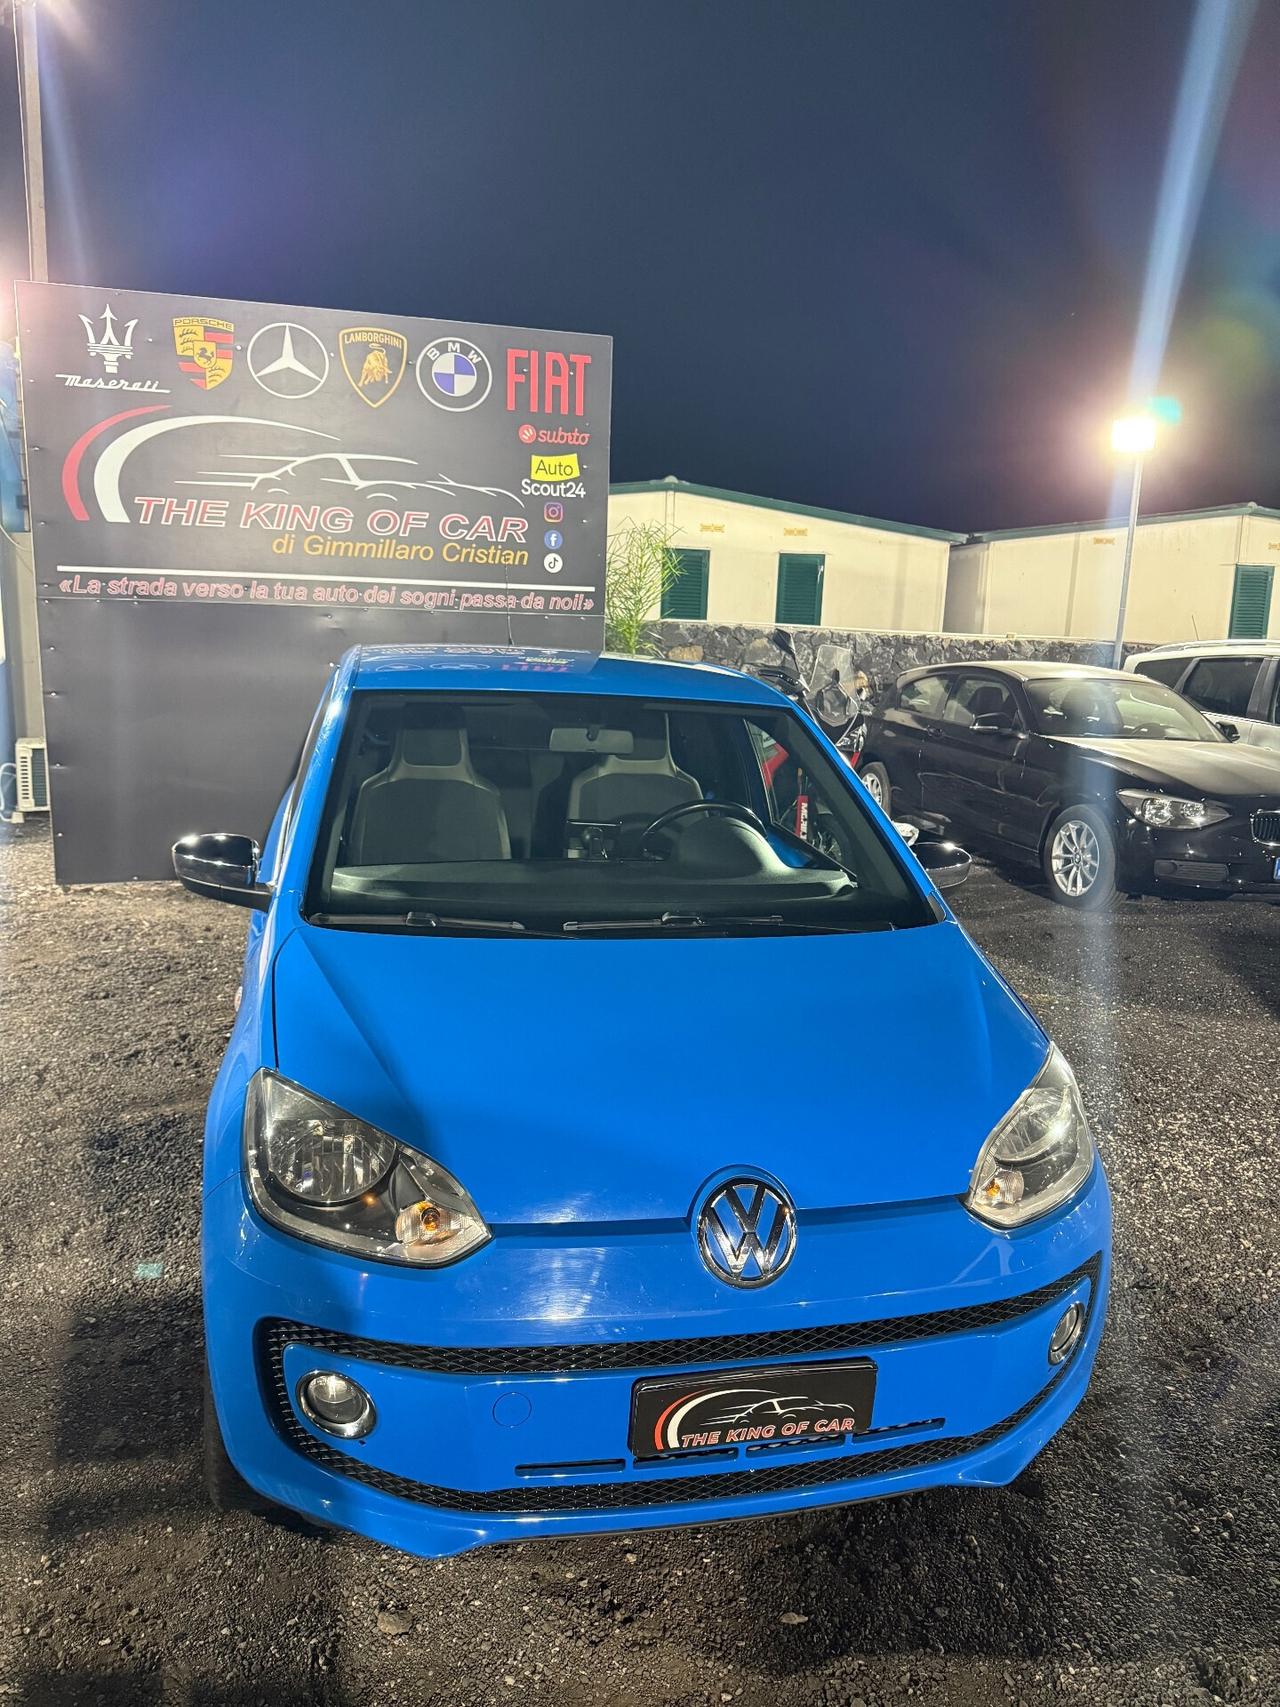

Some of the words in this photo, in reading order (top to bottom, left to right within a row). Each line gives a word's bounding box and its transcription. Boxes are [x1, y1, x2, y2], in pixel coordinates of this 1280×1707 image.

[174, 318, 233, 331] PORSCHE
[344, 333, 402, 349] LAMBORGHINI
[427, 342, 482, 364] BMW
[56, 373, 171, 393] Maserati
[505, 348, 592, 416] FIAT
[538, 427, 590, 446] subito
[535, 459, 574, 477] Auto
[521, 479, 586, 498] Scout24
[134, 496, 229, 527] THE
[239, 501, 354, 533] KING
[367, 509, 430, 537] OF
[438, 513, 529, 543] CAR
[271, 534, 295, 555] di
[303, 534, 434, 561] Gimmillaro
[442, 542, 529, 566] Cristian
[107, 577, 177, 597] strada
[182, 583, 244, 599] verso
[250, 581, 268, 600] la
[274, 583, 307, 601] tua
[312, 585, 358, 603] auto
[364, 585, 396, 604] dei
[400, 589, 456, 609] sogni
[460, 592, 516, 610] passa
[520, 592, 545, 610] da
[681, 1430, 720, 1448] THE
[726, 1424, 776, 1443] KING
[781, 1420, 810, 1436] OF
[814, 1417, 855, 1433] CAR
